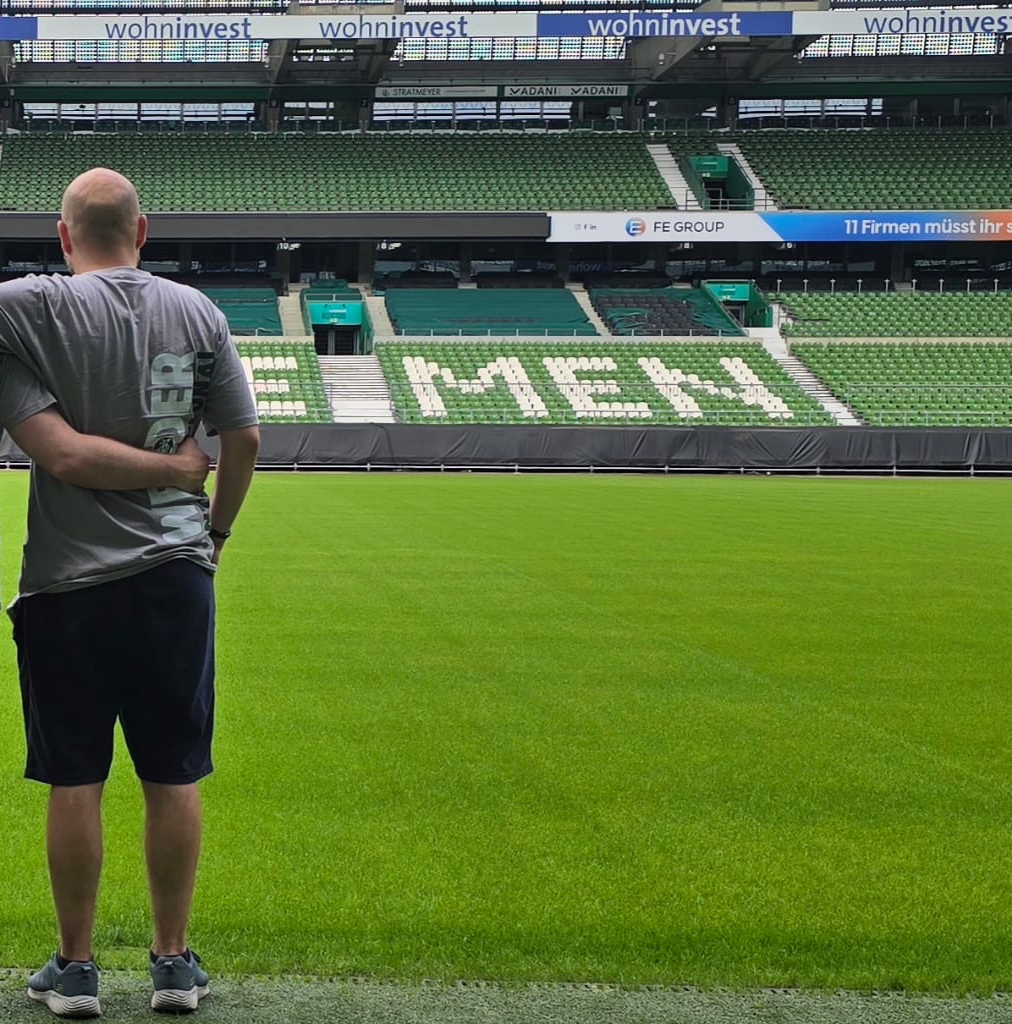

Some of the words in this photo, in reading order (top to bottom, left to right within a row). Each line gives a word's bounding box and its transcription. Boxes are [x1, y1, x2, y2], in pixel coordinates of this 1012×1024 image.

[105, 16, 252, 38] wohninvest
[319, 14, 468, 37] wohninvest
[588, 12, 741, 36] wohninvest
[864, 10, 1012, 33] wohninves
[653, 221, 671, 232] FE
[674, 221, 725, 233] GROUP
[844, 219, 858, 234] 11
[861, 219, 921, 234] Firmen
[925, 219, 976, 234] müsst
[980, 219, 1003, 233] ihr
[144, 351, 204, 545] WDER
